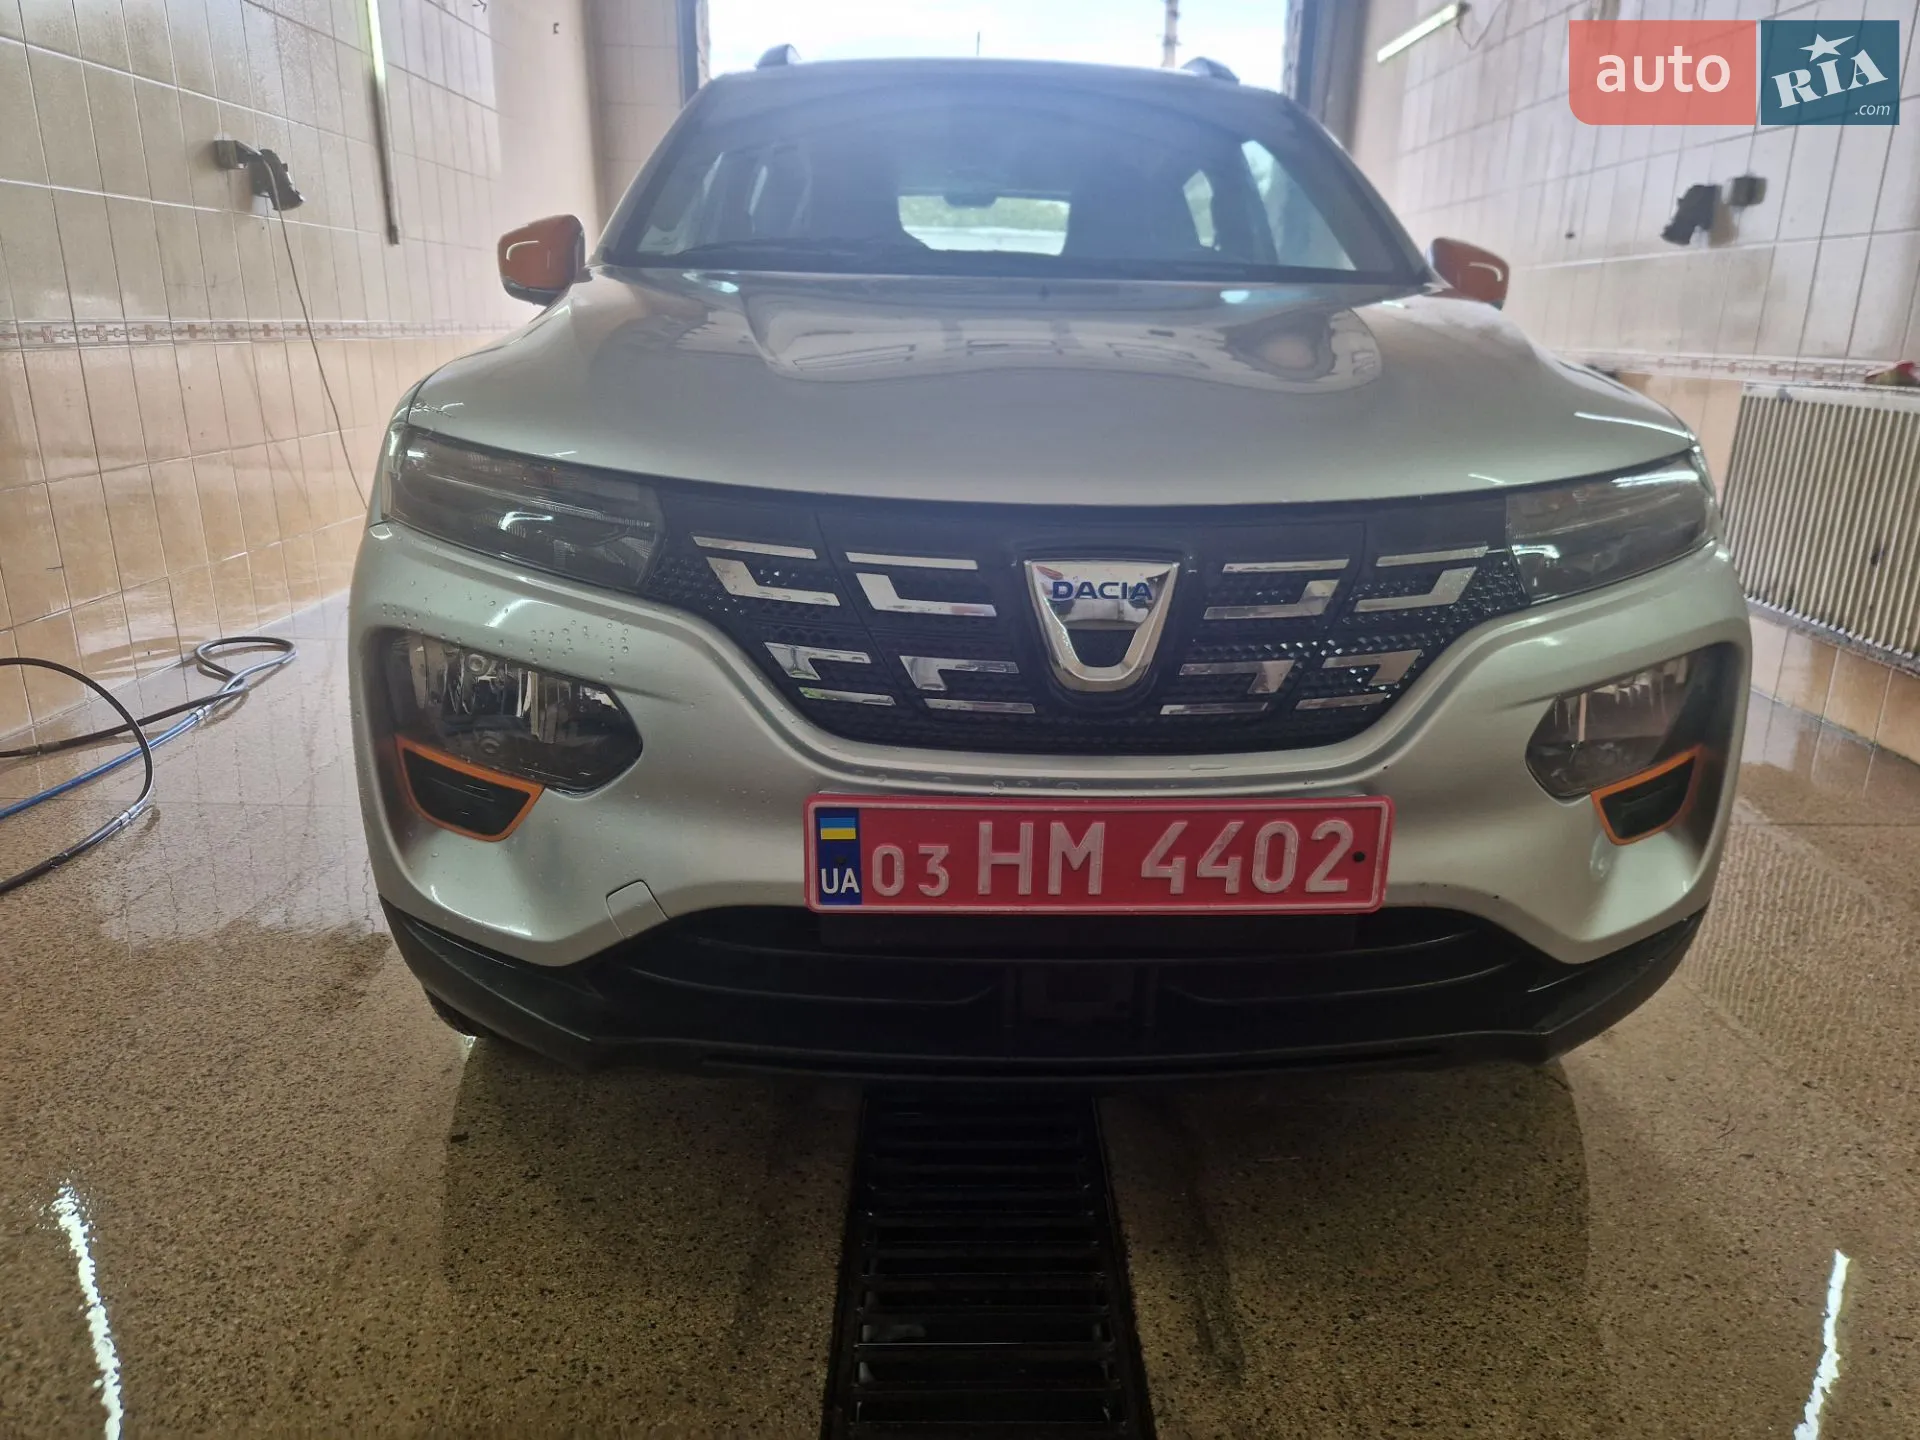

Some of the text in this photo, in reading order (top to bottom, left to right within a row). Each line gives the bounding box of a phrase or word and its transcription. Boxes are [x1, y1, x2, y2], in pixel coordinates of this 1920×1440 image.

[1052, 581, 1153, 600] DACIA
[872, 819, 1355, 897] 03 HM 4402
[820, 867, 861, 895] UA
